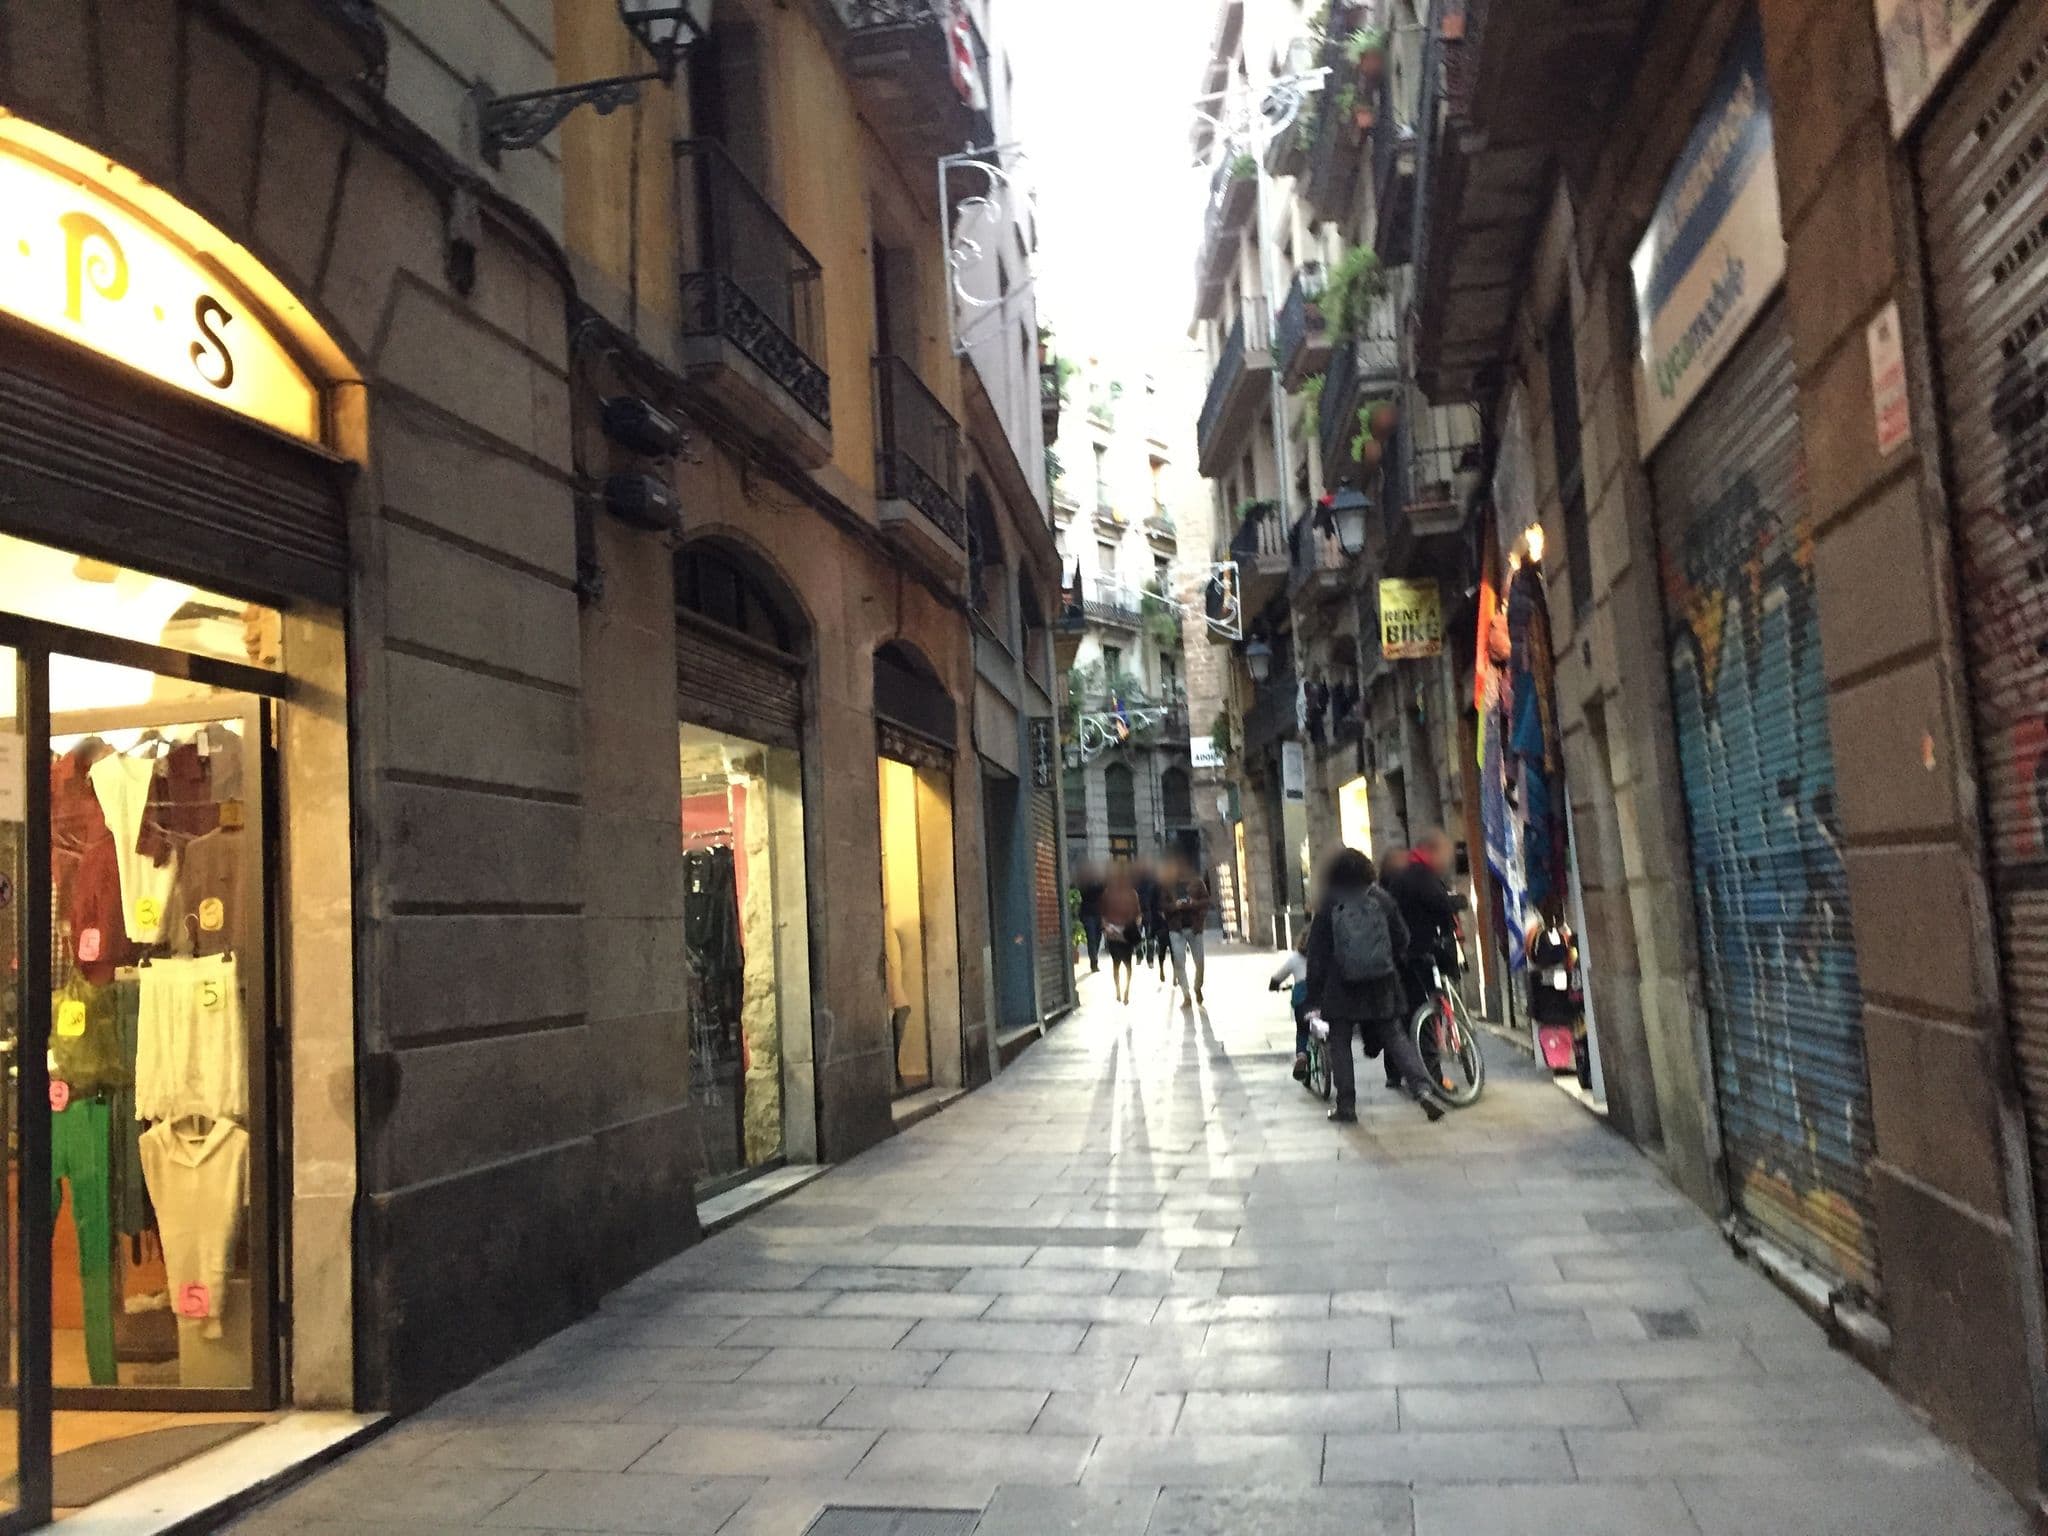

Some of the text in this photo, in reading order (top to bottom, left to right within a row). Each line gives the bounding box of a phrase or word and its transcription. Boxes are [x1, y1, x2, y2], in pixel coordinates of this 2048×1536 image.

[1384, 609, 1420, 622] RENT
[1386, 623, 1441, 644] BIKE
[203, 980, 219, 1007] 5
[184, 1285, 205, 1314] 5
